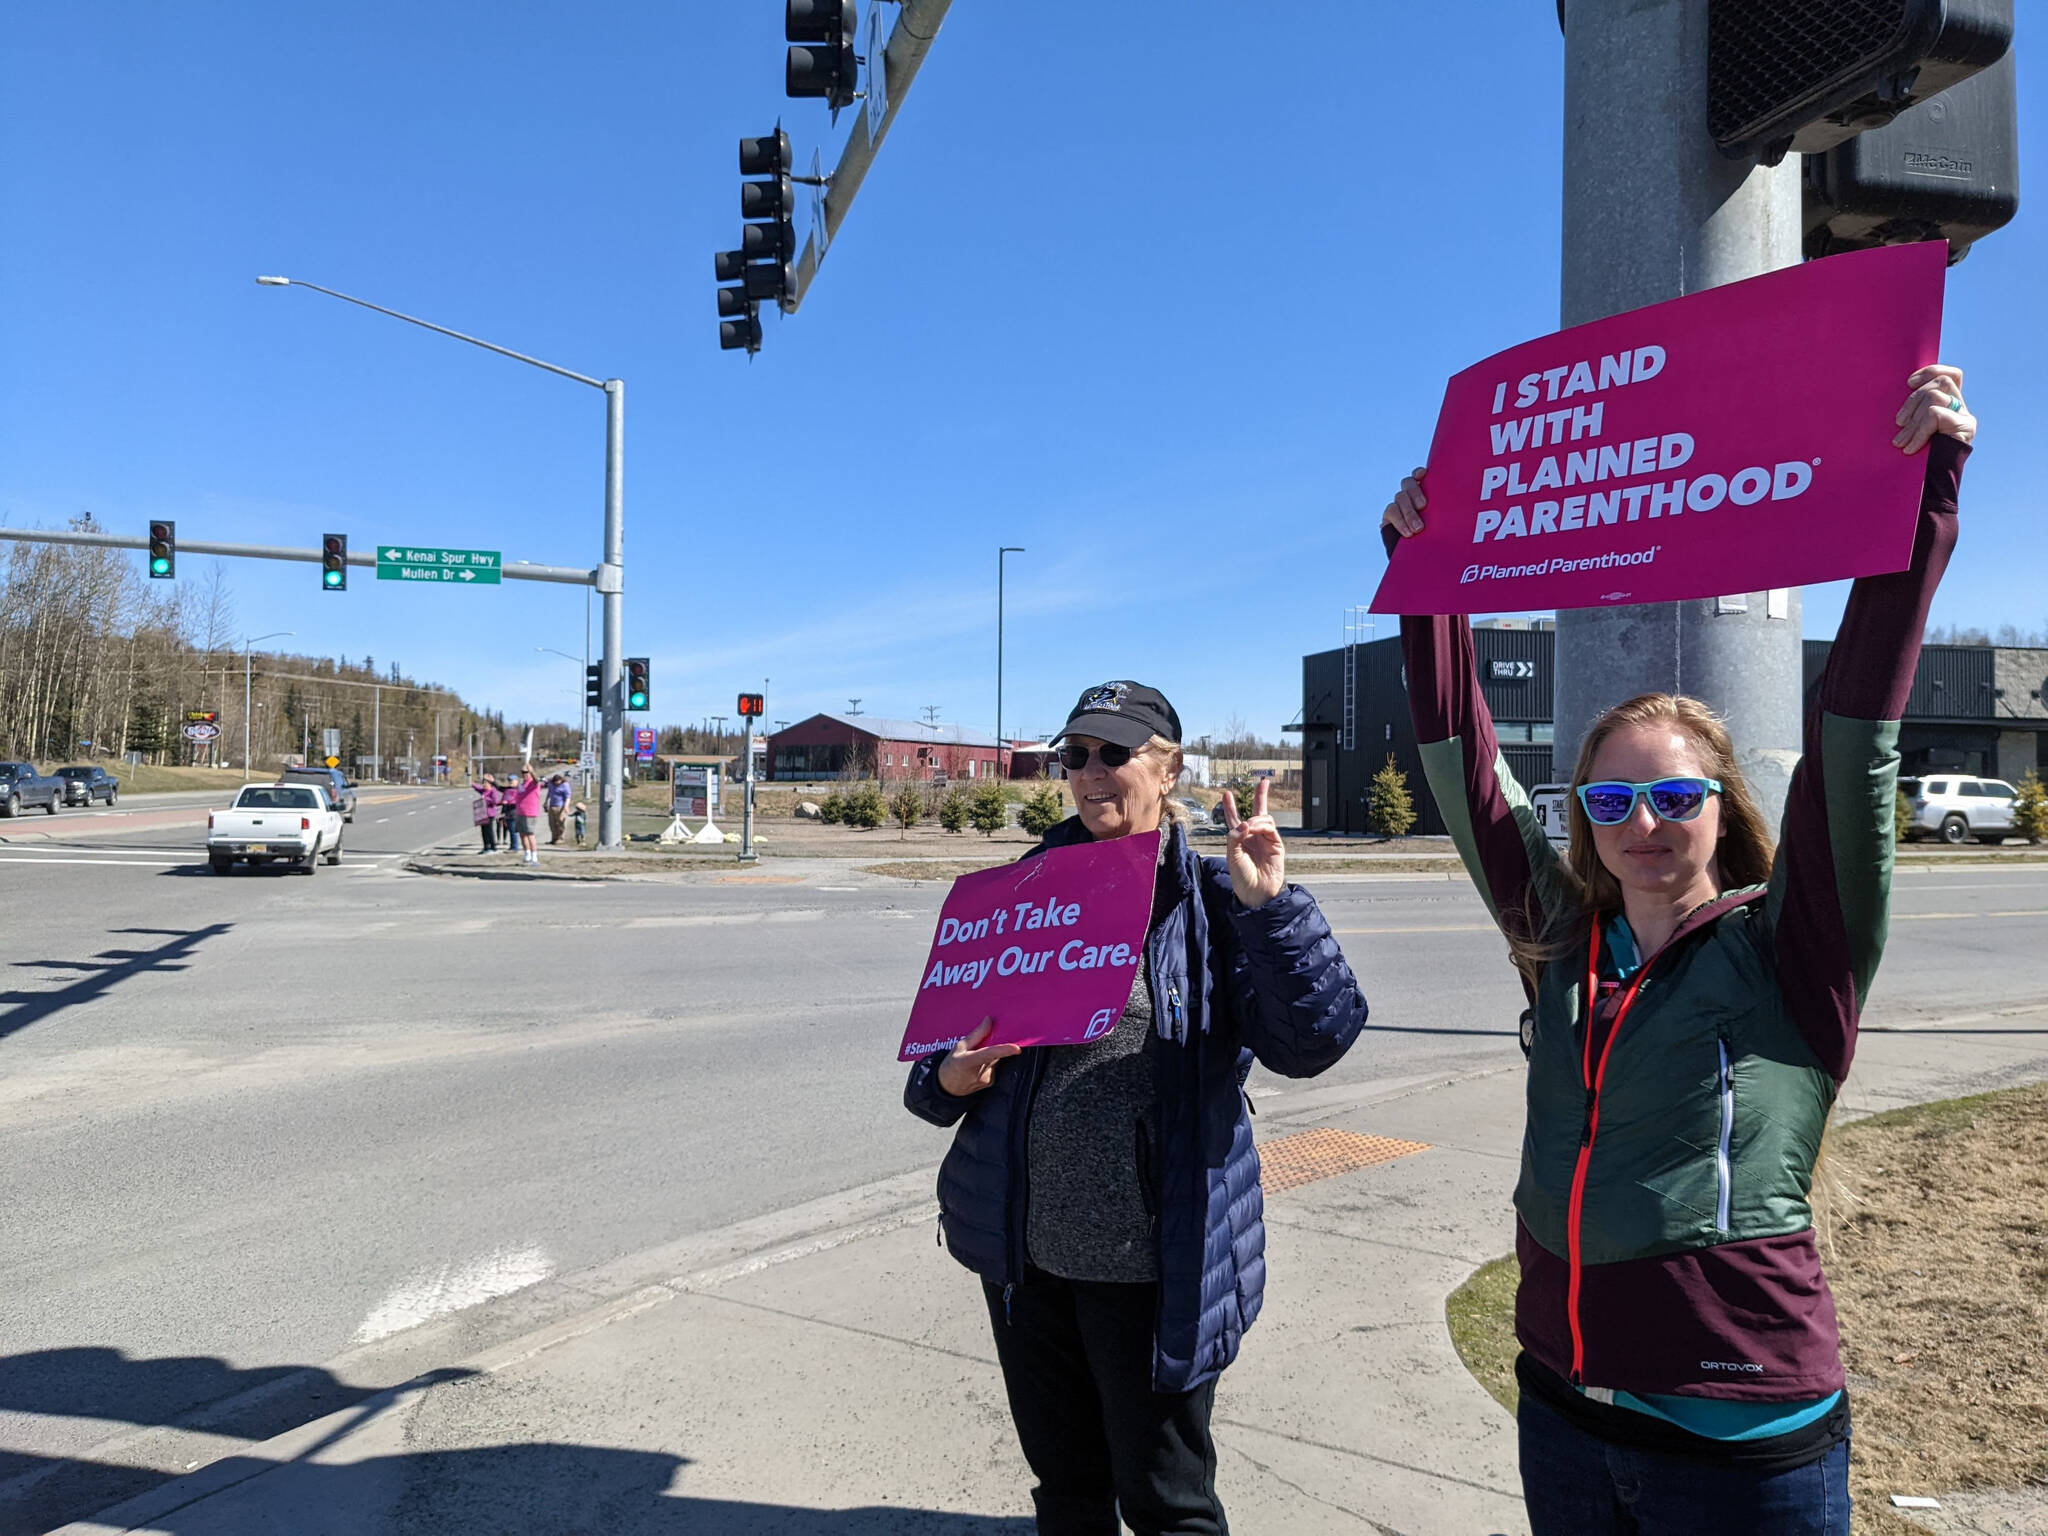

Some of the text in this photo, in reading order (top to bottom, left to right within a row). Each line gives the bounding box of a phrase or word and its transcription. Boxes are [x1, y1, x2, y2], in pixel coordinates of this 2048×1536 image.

[1491, 344, 1667, 415] I STAND
[1489, 400, 1605, 456] WITH
[1479, 431, 1696, 501] PLANNED
[406, 550, 495, 568] Kenai Spur Hwy
[401, 567, 456, 581] Mullen Dr
[1479, 559, 1549, 580] Planned
[1492, 661, 1515, 670] DRIVE
[1493, 669, 1514, 677] THRU
[752, 698, 763, 713] 11
[937, 896, 1081, 947] Don't Take
[922, 939, 1138, 990] Away Our Care.
[1700, 1360, 1764, 1373] ORTOVOX
